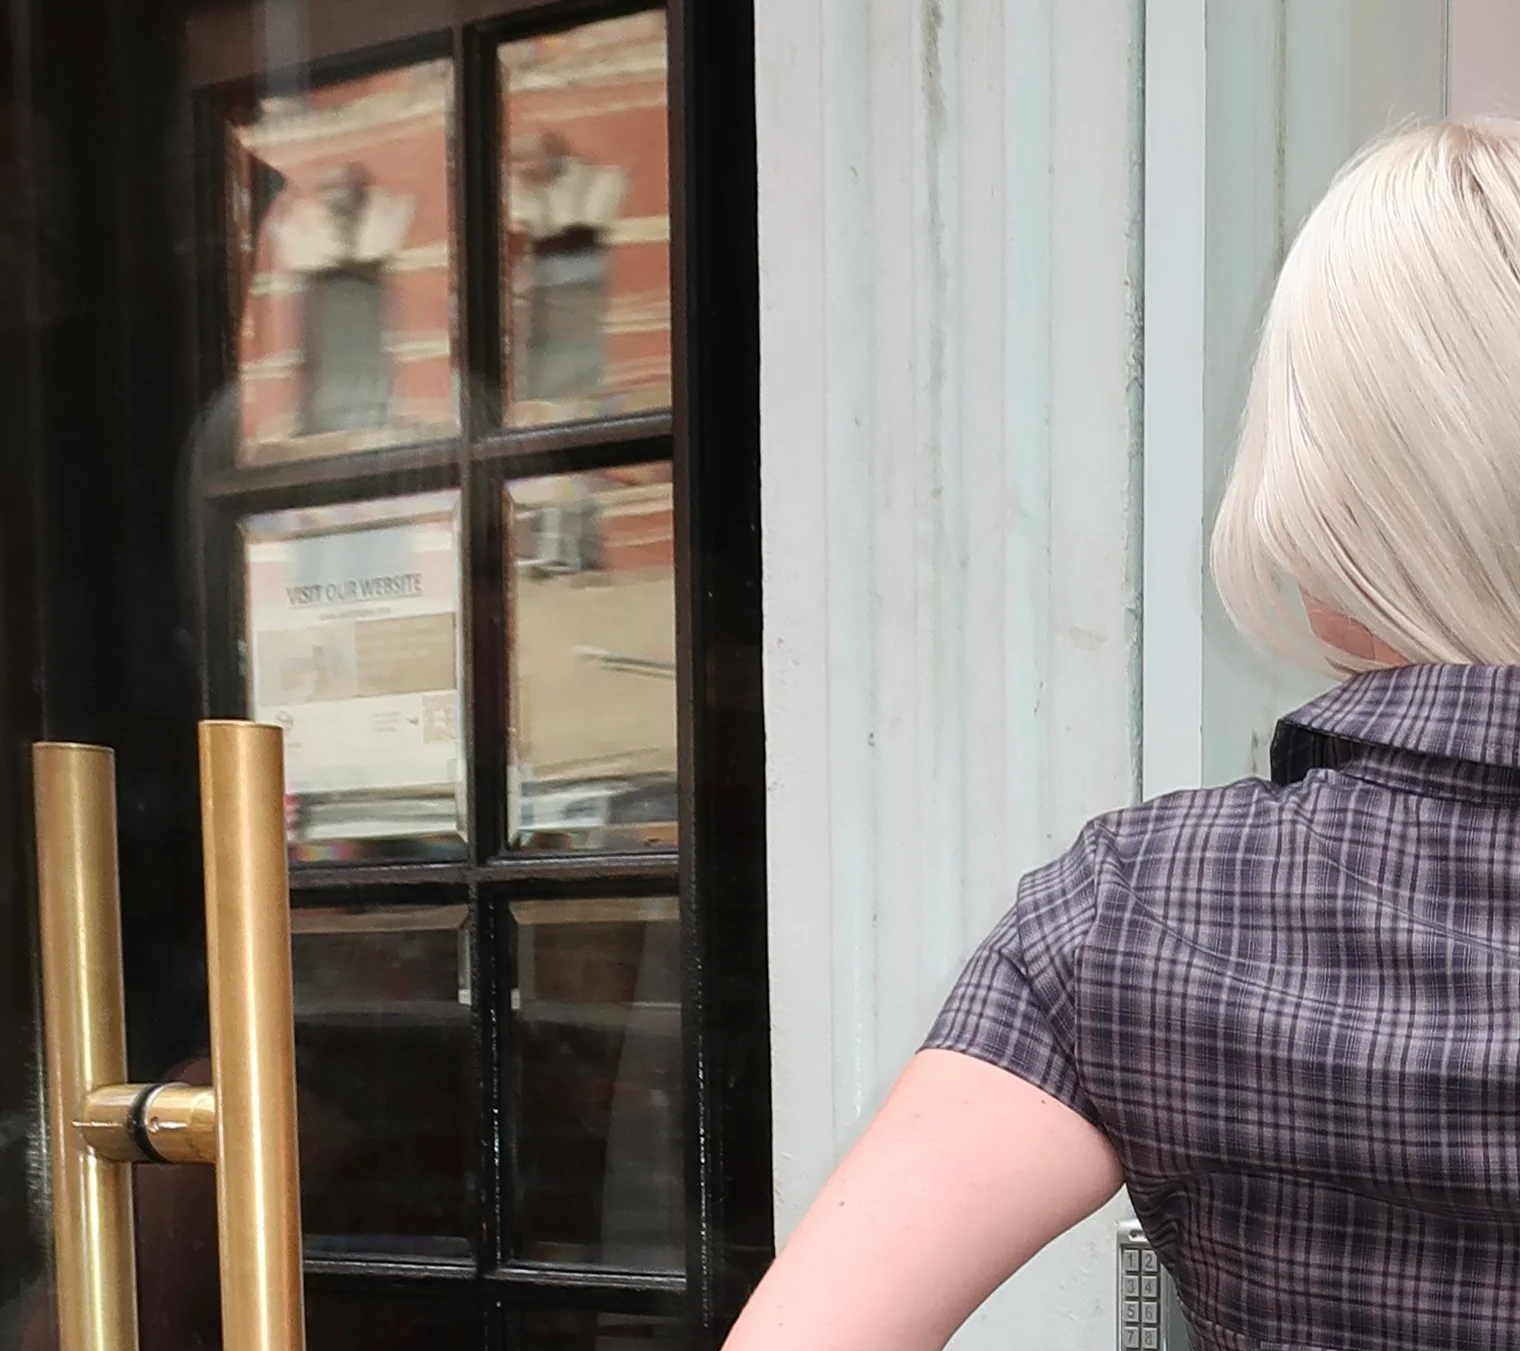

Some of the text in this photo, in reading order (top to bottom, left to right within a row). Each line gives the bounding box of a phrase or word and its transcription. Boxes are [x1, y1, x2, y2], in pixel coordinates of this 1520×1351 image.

[286, 573, 423, 606] VISIT OUR WEBSITE
[1145, 1252, 1153, 1269] 2
[1145, 1280, 1152, 1293] 4
[1145, 1305, 1152, 1320] 6
[1145, 1331, 1152, 1345] 8
